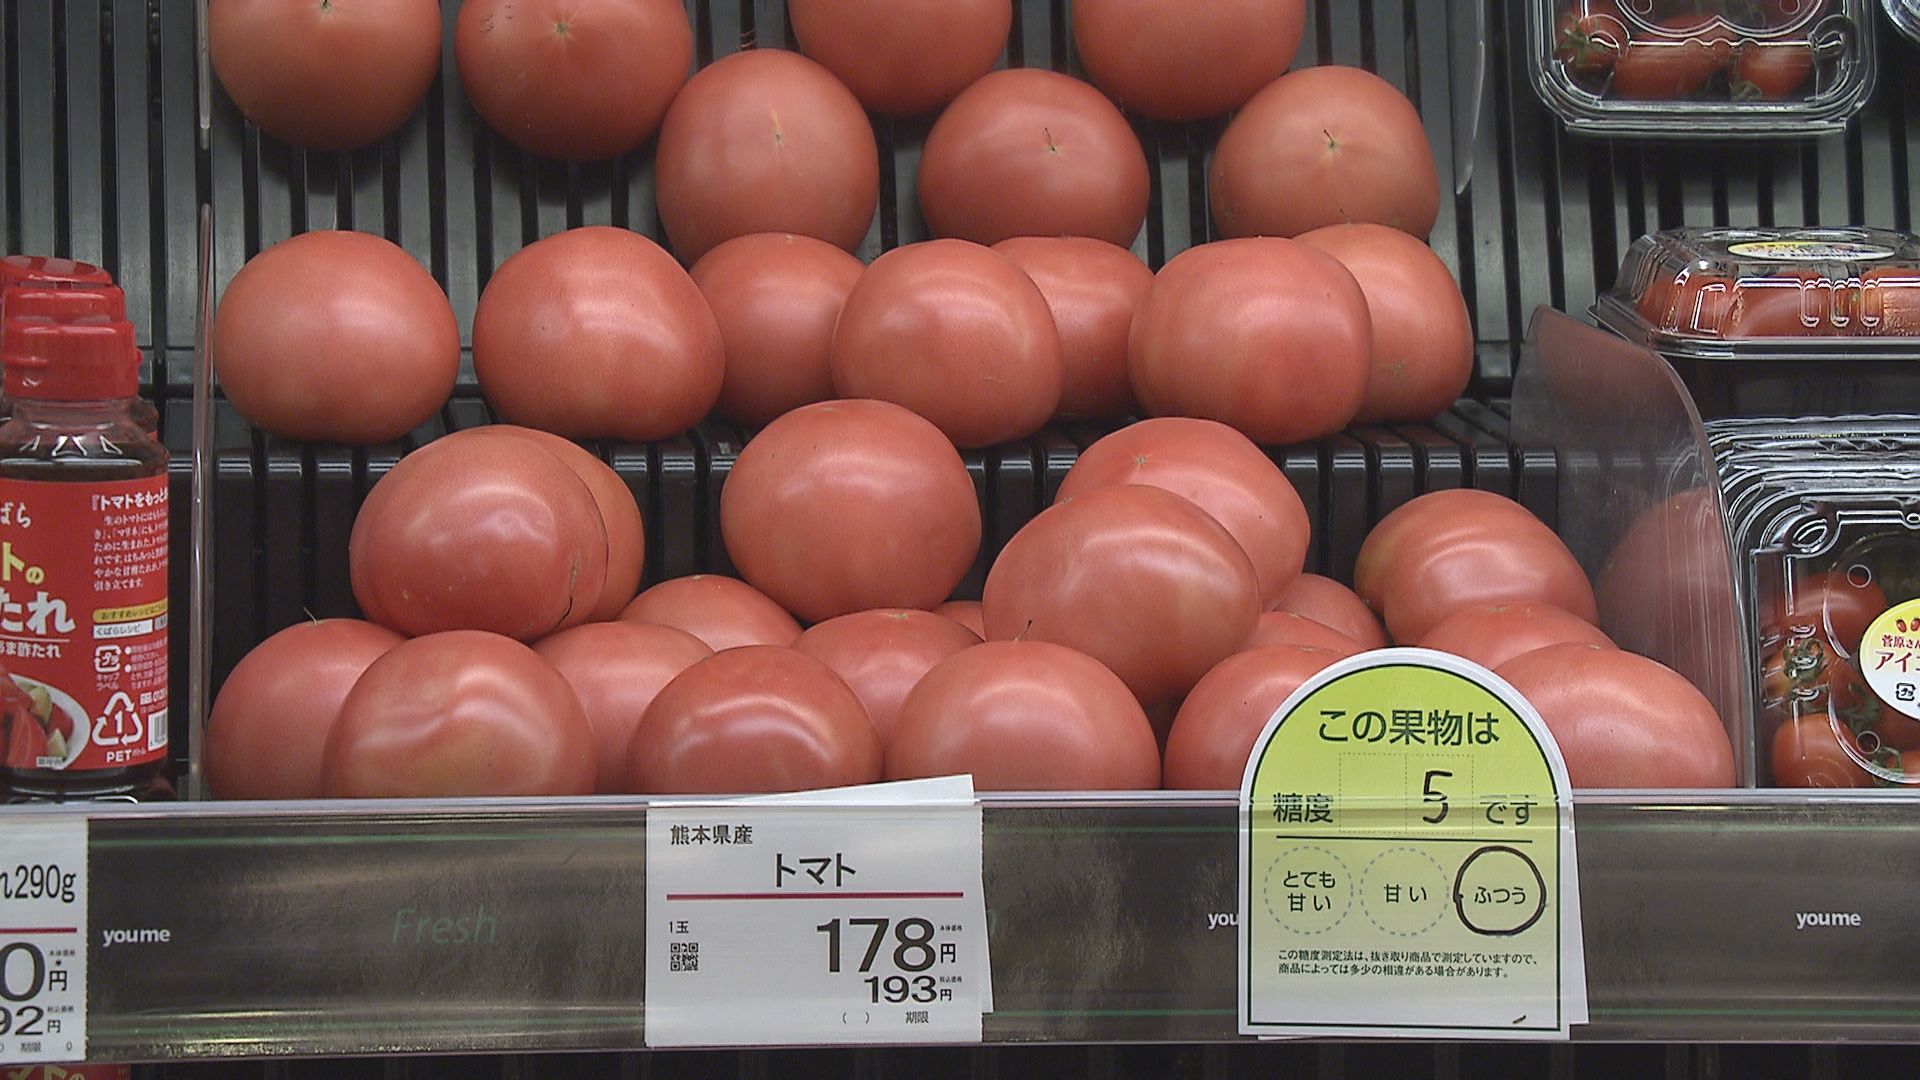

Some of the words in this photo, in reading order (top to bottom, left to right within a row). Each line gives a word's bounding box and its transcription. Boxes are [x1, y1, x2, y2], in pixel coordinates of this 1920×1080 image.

[1875, 651, 1920, 673] アイ
[1319, 709, 1499, 745] この果物は
[106, 750, 132, 763] PET
[1273, 792, 1334, 824] 糖度
[1422, 769, 1453, 824] 5
[1479, 794, 1538, 825] です
[670, 824, 753, 845] 熊本県産
[776, 852, 857, 888] トマト
[1282, 869, 1336, 889] とても
[1287, 892, 1331, 912] 甘い
[1384, 883, 1427, 904] 甘い
[1473, 886, 1527, 905] ふつう
[392, 903, 498, 945] Fresh
[669, 921, 689, 934] 1玉
[1796, 911, 1862, 930] youme
[103, 928, 170, 948] youme
[905, 1011, 930, 1024] 期限
